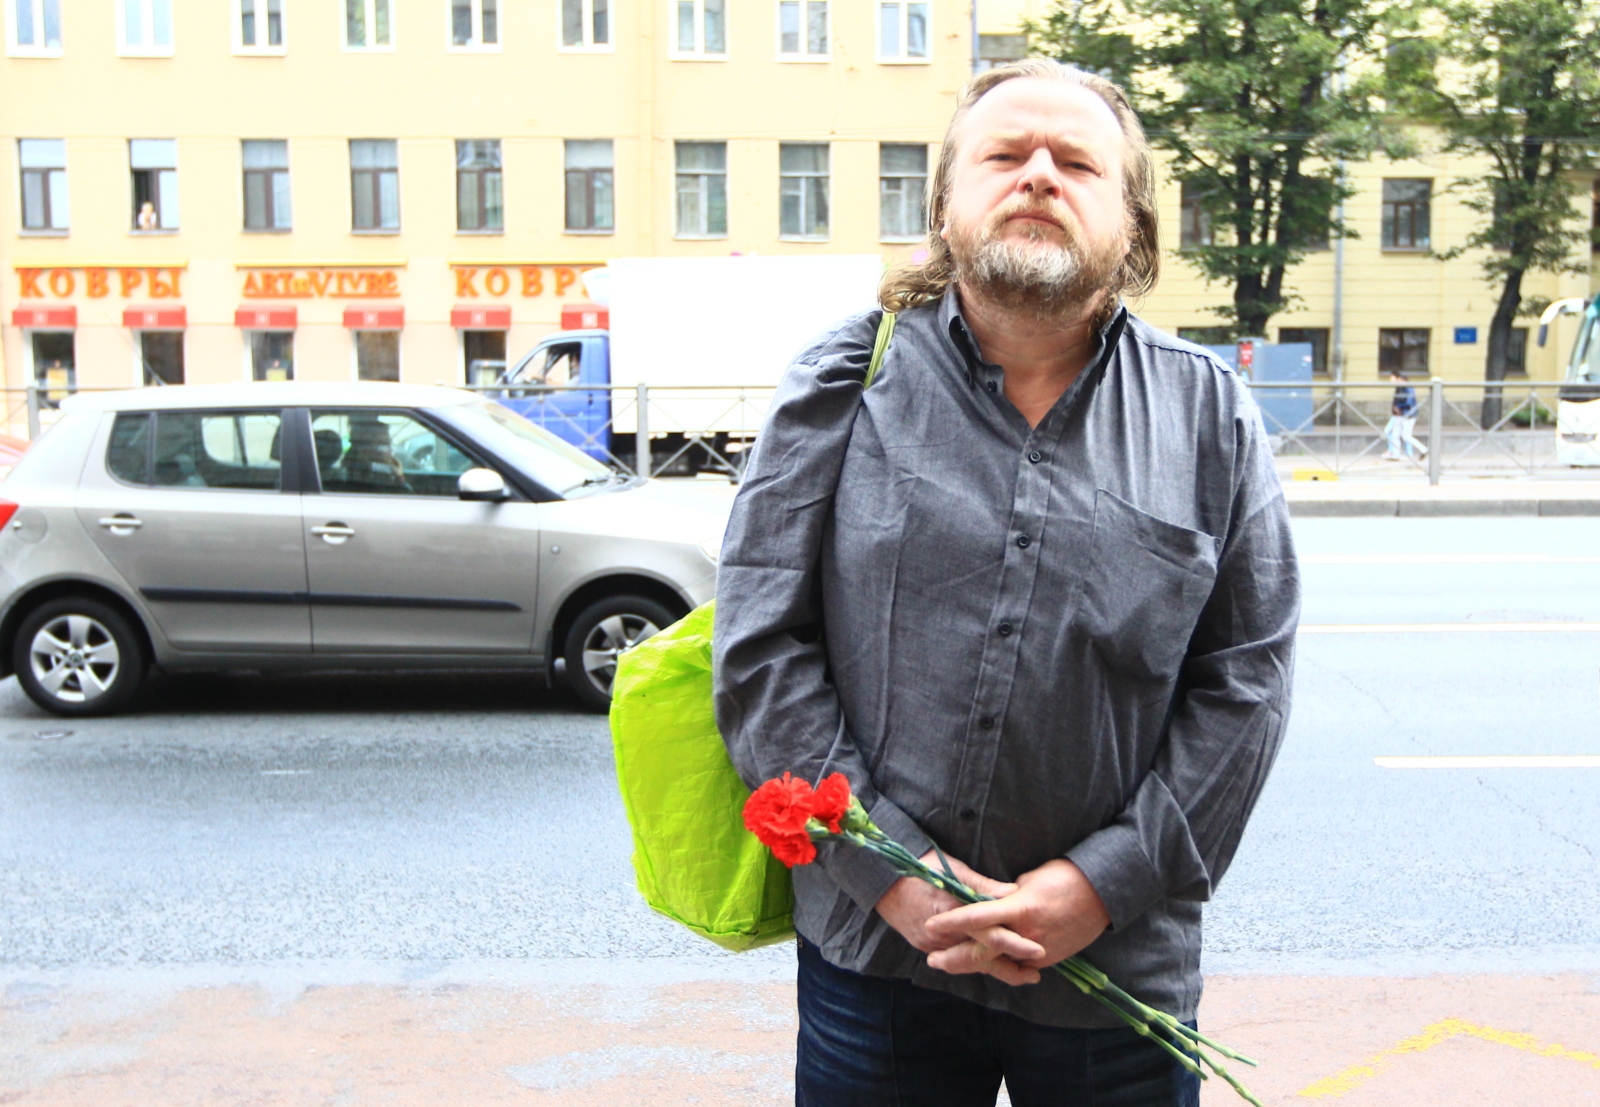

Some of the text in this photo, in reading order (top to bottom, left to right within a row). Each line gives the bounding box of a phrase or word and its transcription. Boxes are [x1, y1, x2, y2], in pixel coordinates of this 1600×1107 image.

[18, 267, 182, 298] КОВРЫ
[243, 271, 295, 294] ART
[454, 266, 590, 297] КОВР
